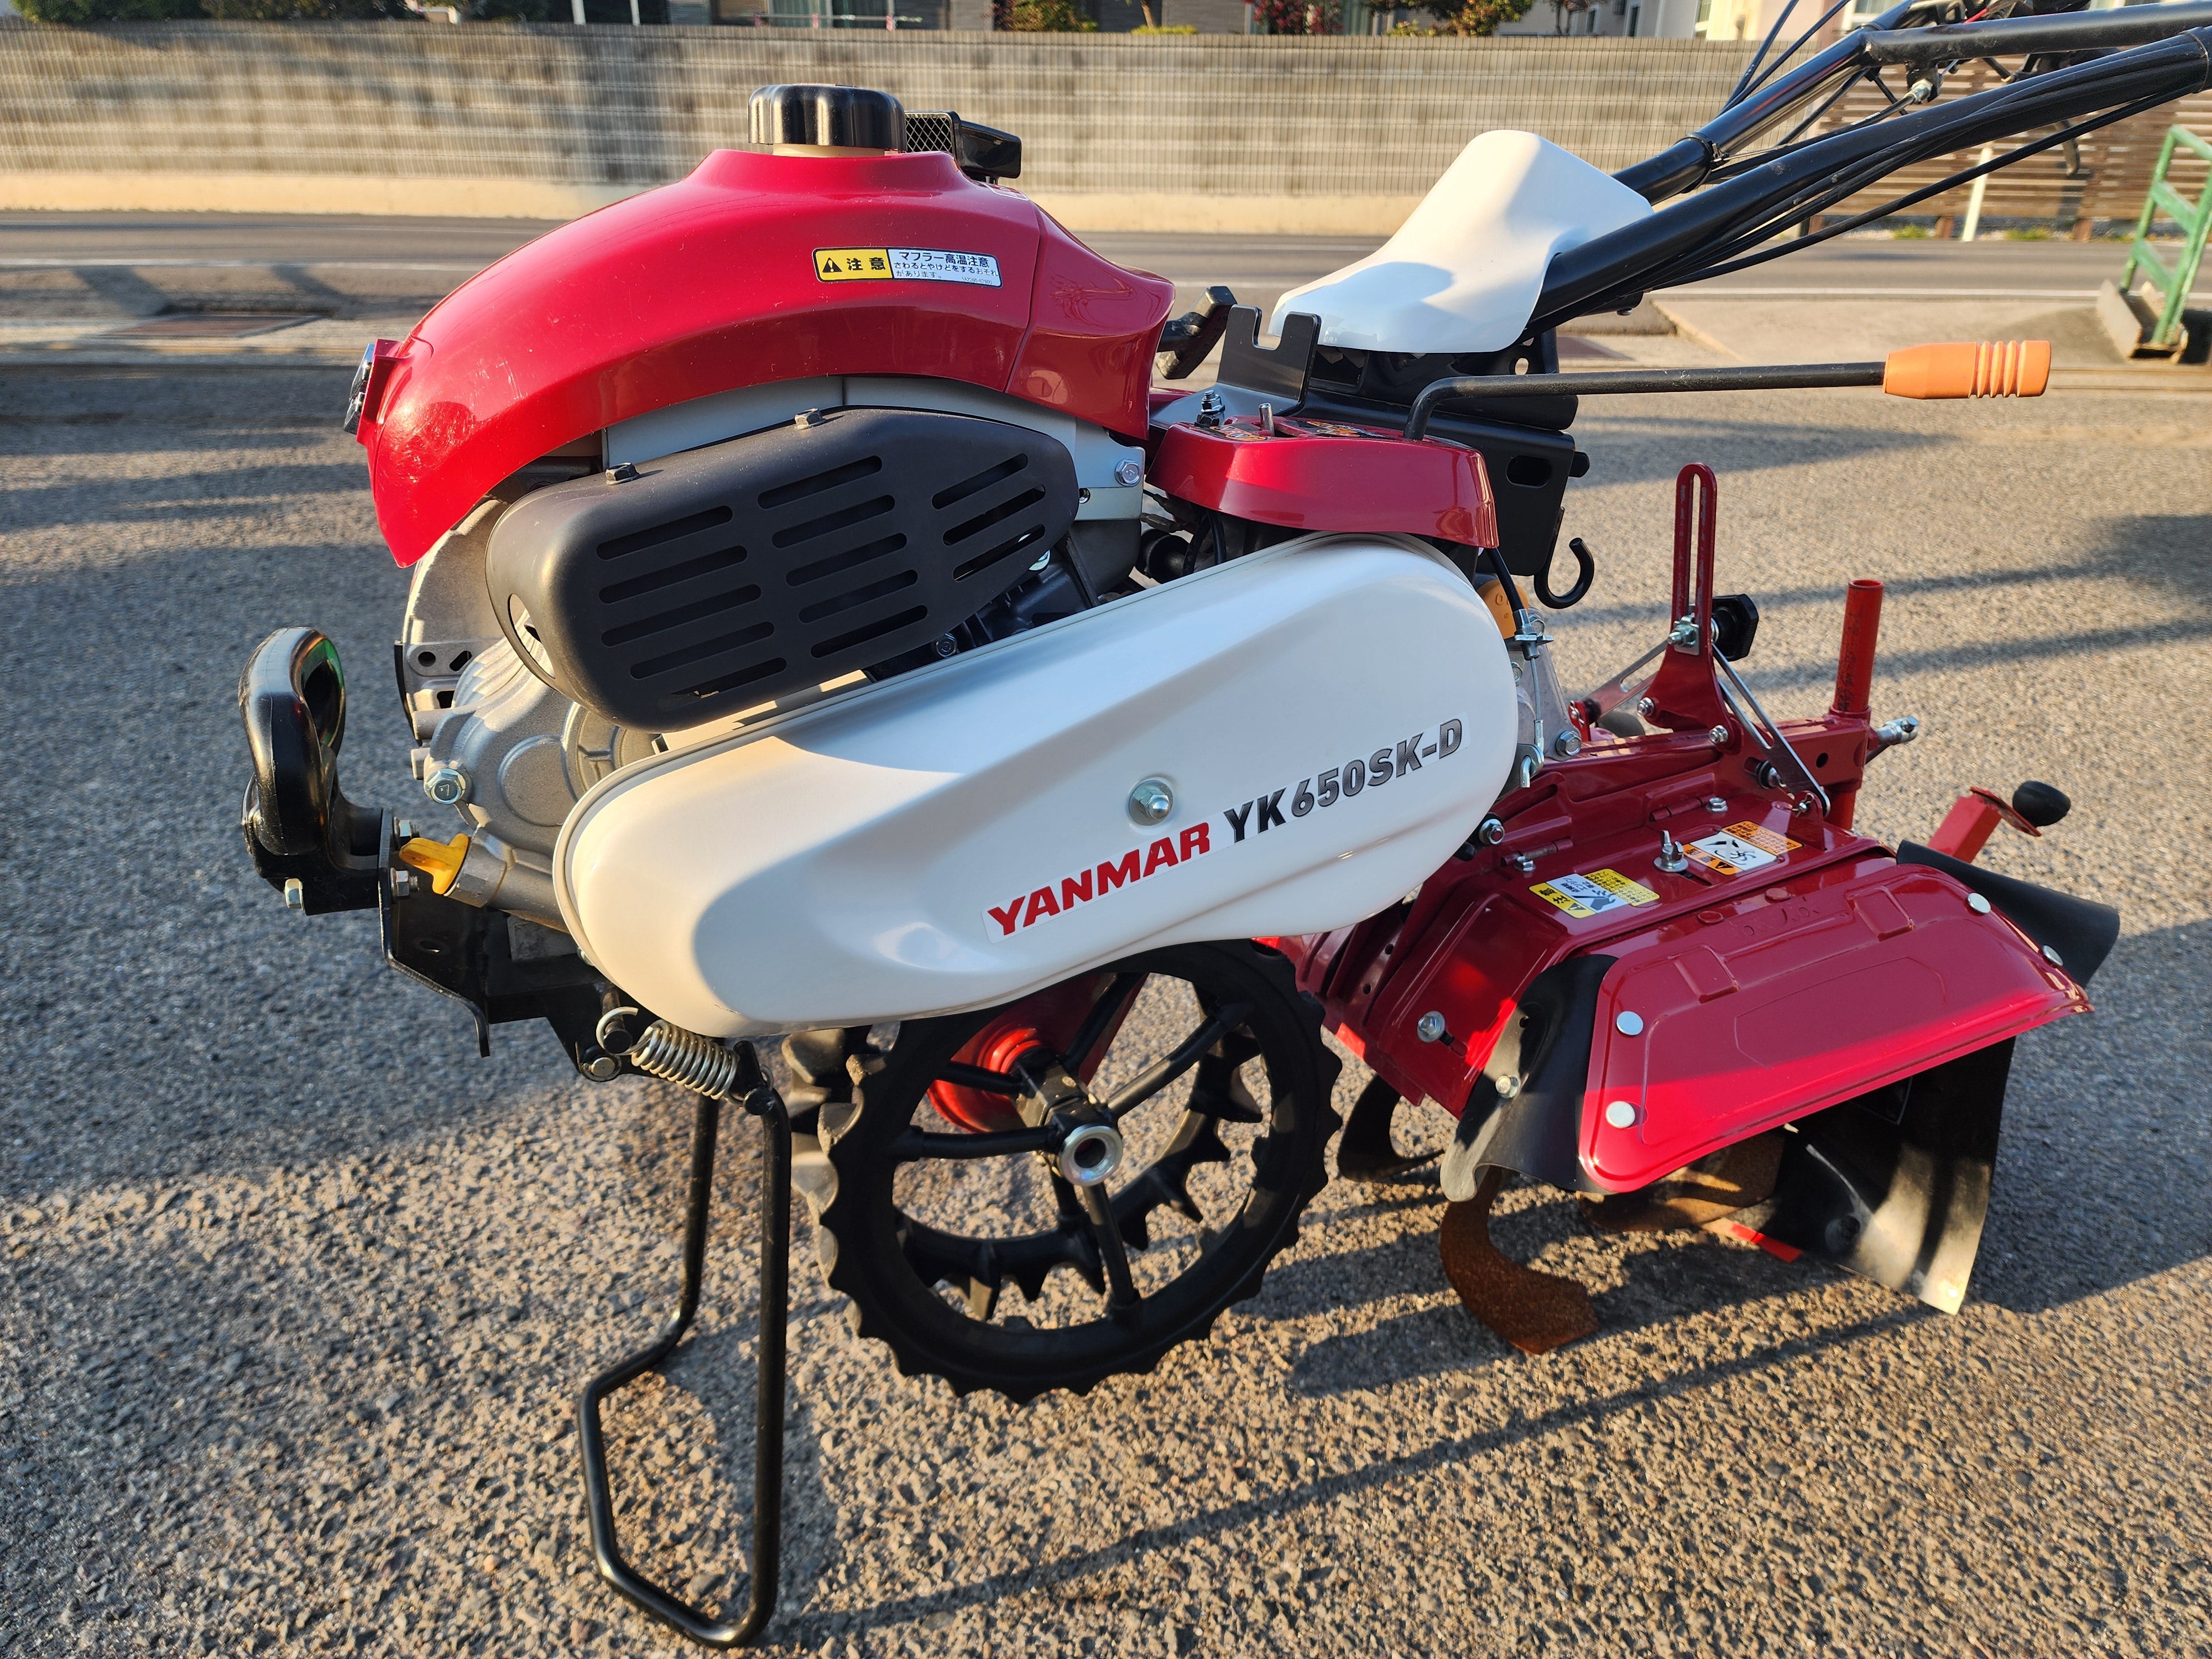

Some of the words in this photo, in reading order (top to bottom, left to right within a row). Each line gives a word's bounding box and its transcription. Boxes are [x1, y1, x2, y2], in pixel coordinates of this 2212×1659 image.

[847, 257, 886, 270] 注意
[899, 252, 989, 267] マフラー高温注意
[894, 262, 998, 276] さわるとやけどをするおそれ
[896, 270, 942, 279] があります。
[987, 822, 1210, 936] YANMAR
[1223, 718, 1463, 844] YK650SK-D
